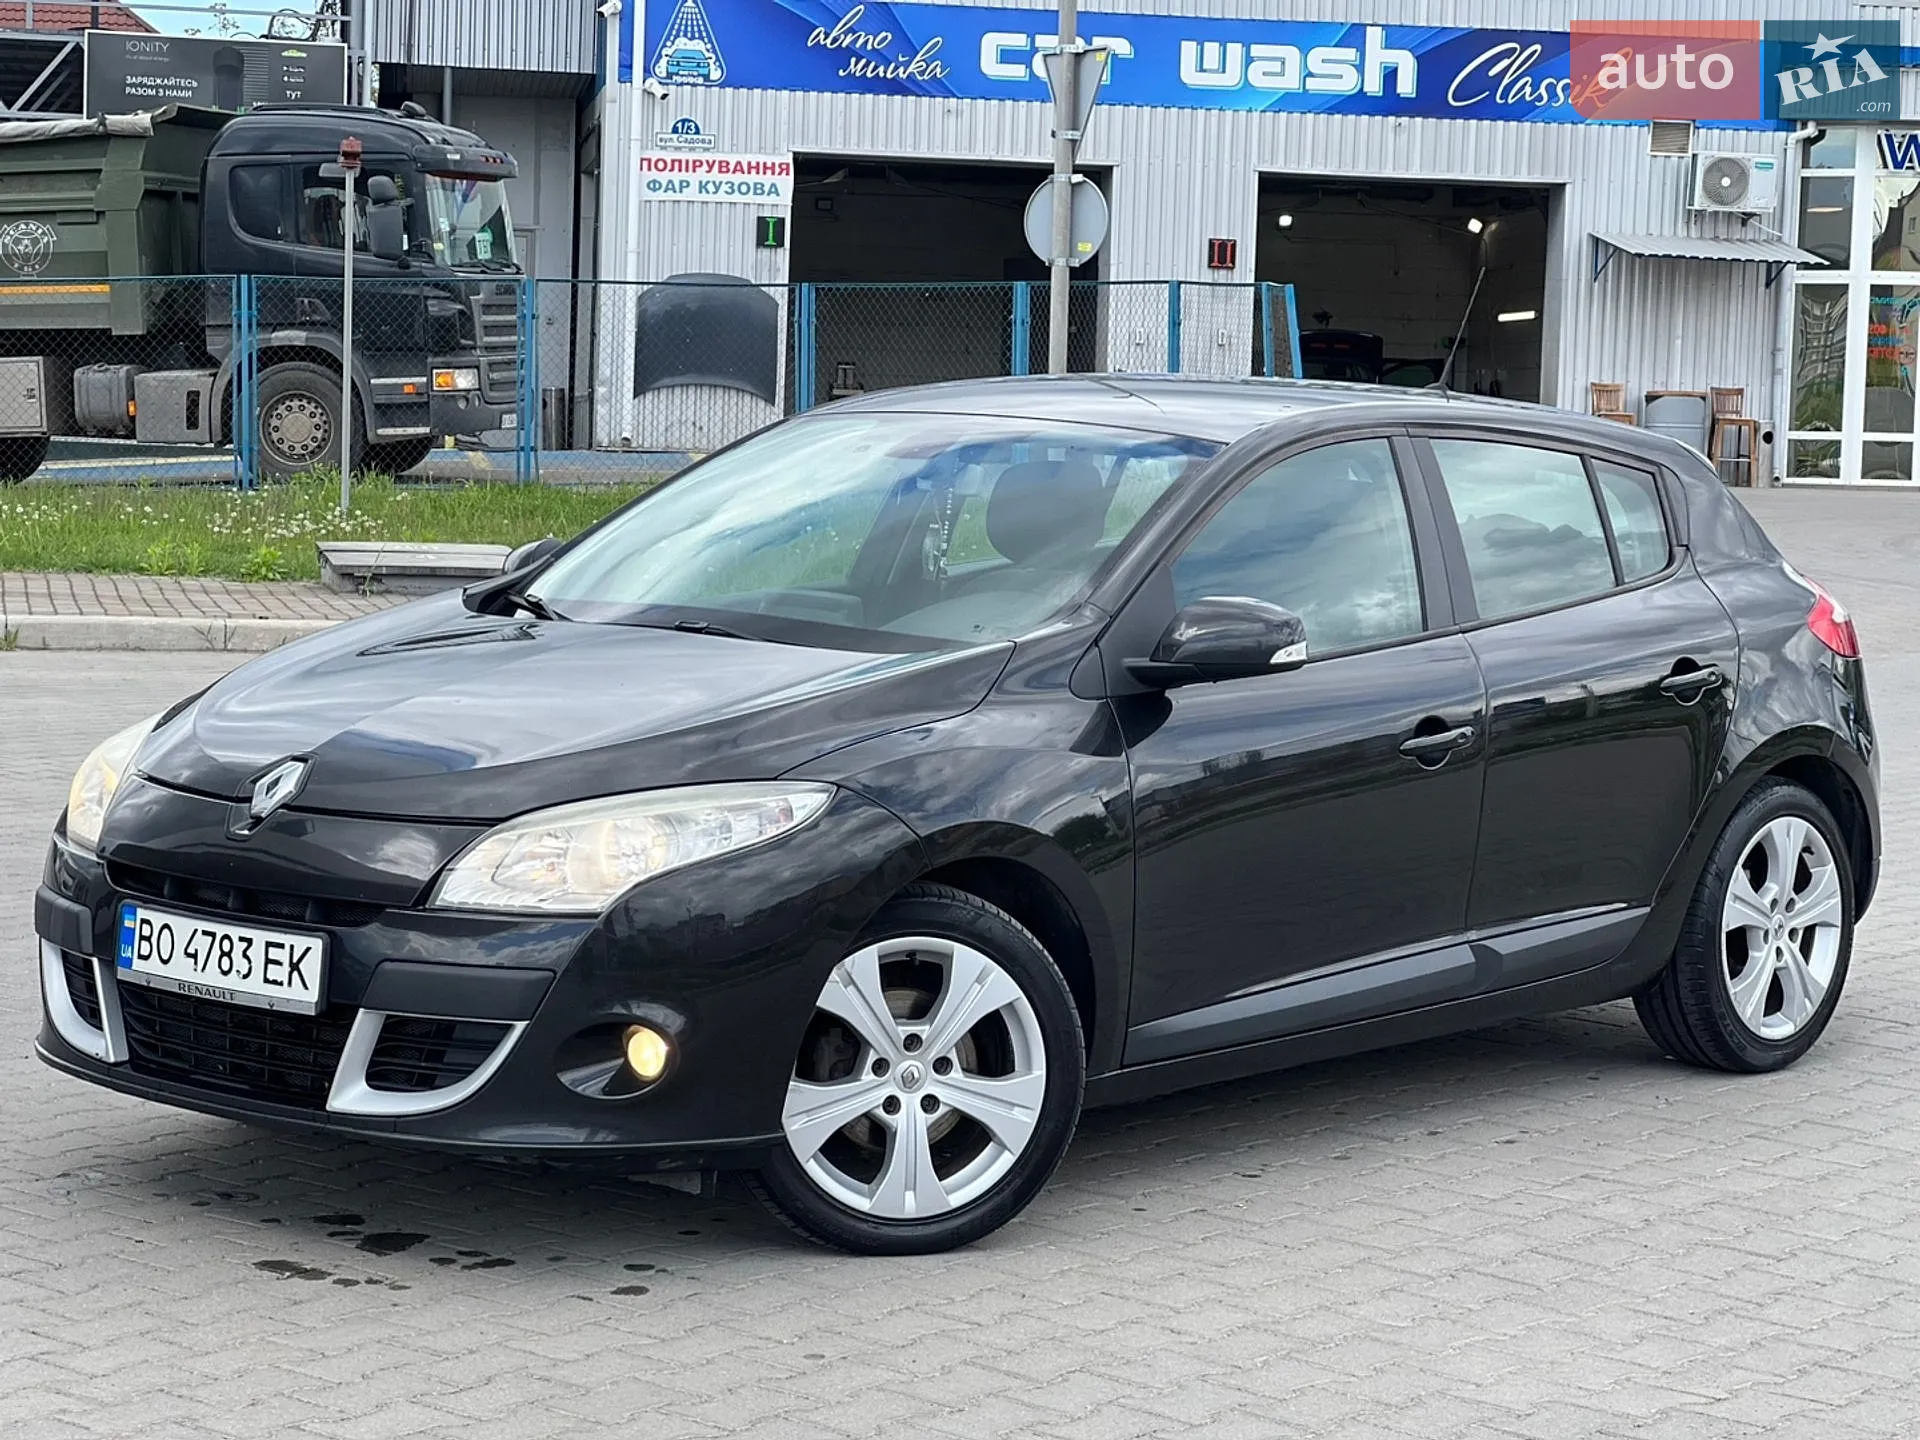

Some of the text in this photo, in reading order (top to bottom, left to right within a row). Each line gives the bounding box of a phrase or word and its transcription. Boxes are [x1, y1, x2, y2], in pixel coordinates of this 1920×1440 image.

[807, 4, 892, 50] авто
[126, 40, 170, 52] IONITY
[838, 37, 950, 80] мийка
[1179, 25, 1417, 97] wash
[125, 75, 198, 88] ЗАРЯДЖАЙТЕСЬ
[125, 87, 156, 96] РАЗОМ
[165, 89, 193, 98] НАМИ
[676, 121, 696, 134] 1/3
[676, 134, 713, 145] Садова
[640, 157, 791, 176] ПОЛІРУВАННЯ
[646, 178, 780, 197] ФАР КУЗОВА
[121, 944, 132, 958] UA
[137, 917, 312, 991] BO 4783 EK
[178, 983, 236, 1001] RENAULT
